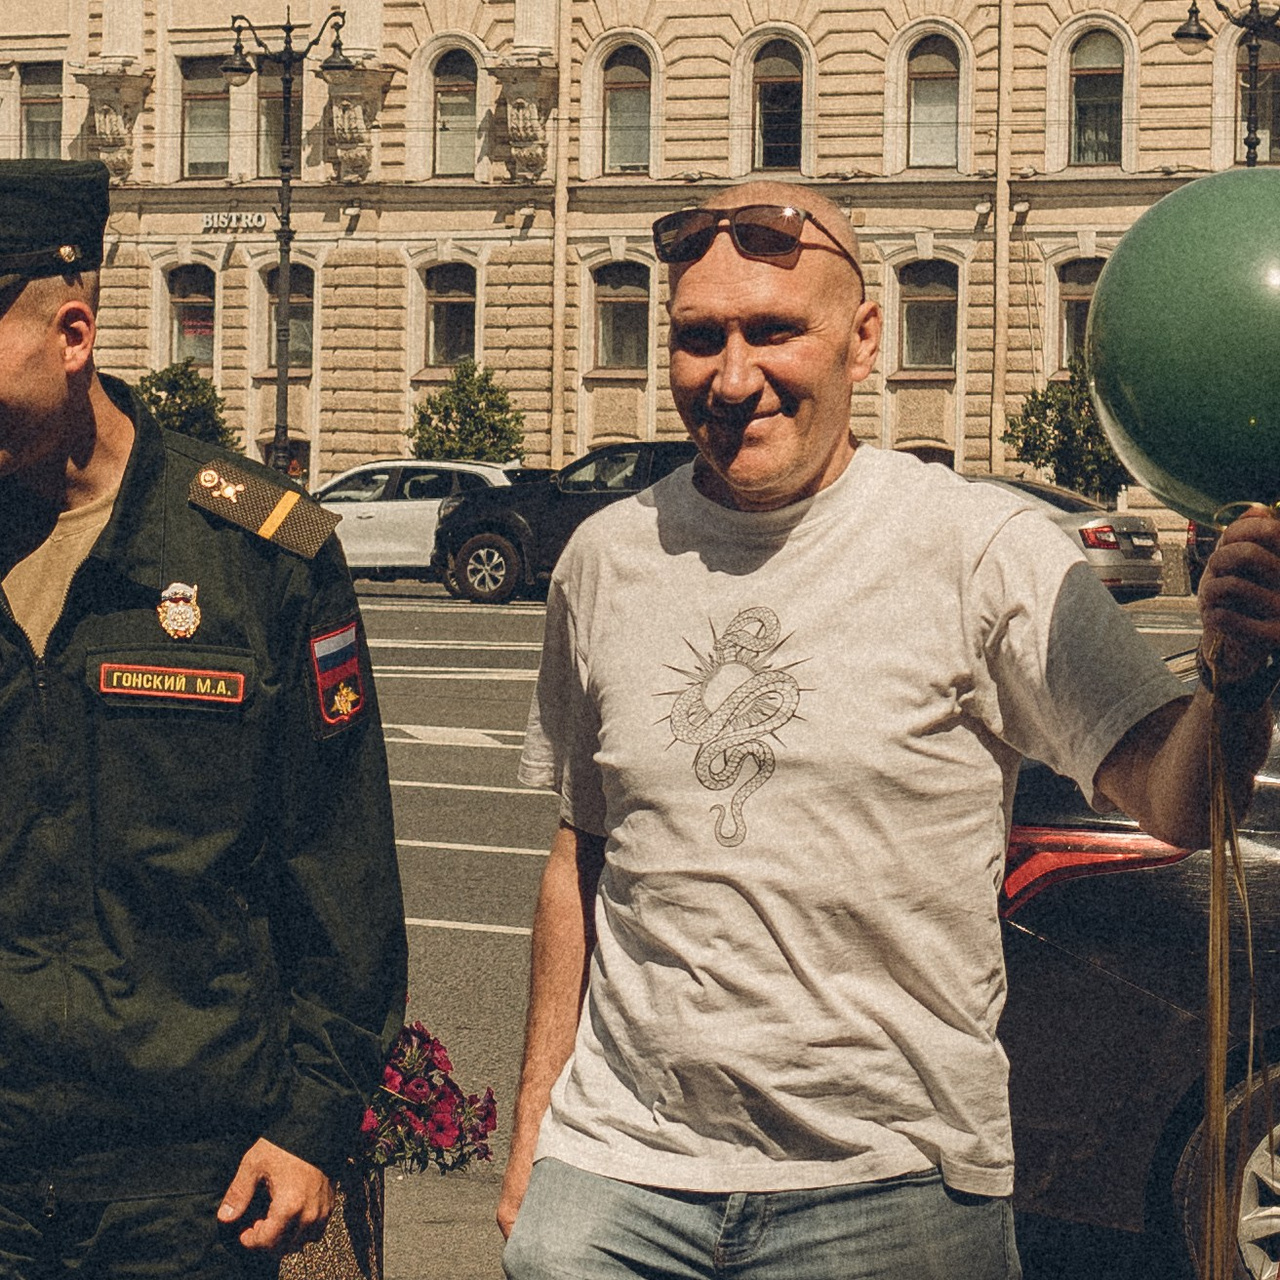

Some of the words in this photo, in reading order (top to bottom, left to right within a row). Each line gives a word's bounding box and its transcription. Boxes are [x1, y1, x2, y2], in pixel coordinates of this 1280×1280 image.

[203, 213, 266, 228] BISTRO
[112, 672, 186, 691] ГОНСКИЙ
[196, 677, 232, 695] М.А.
